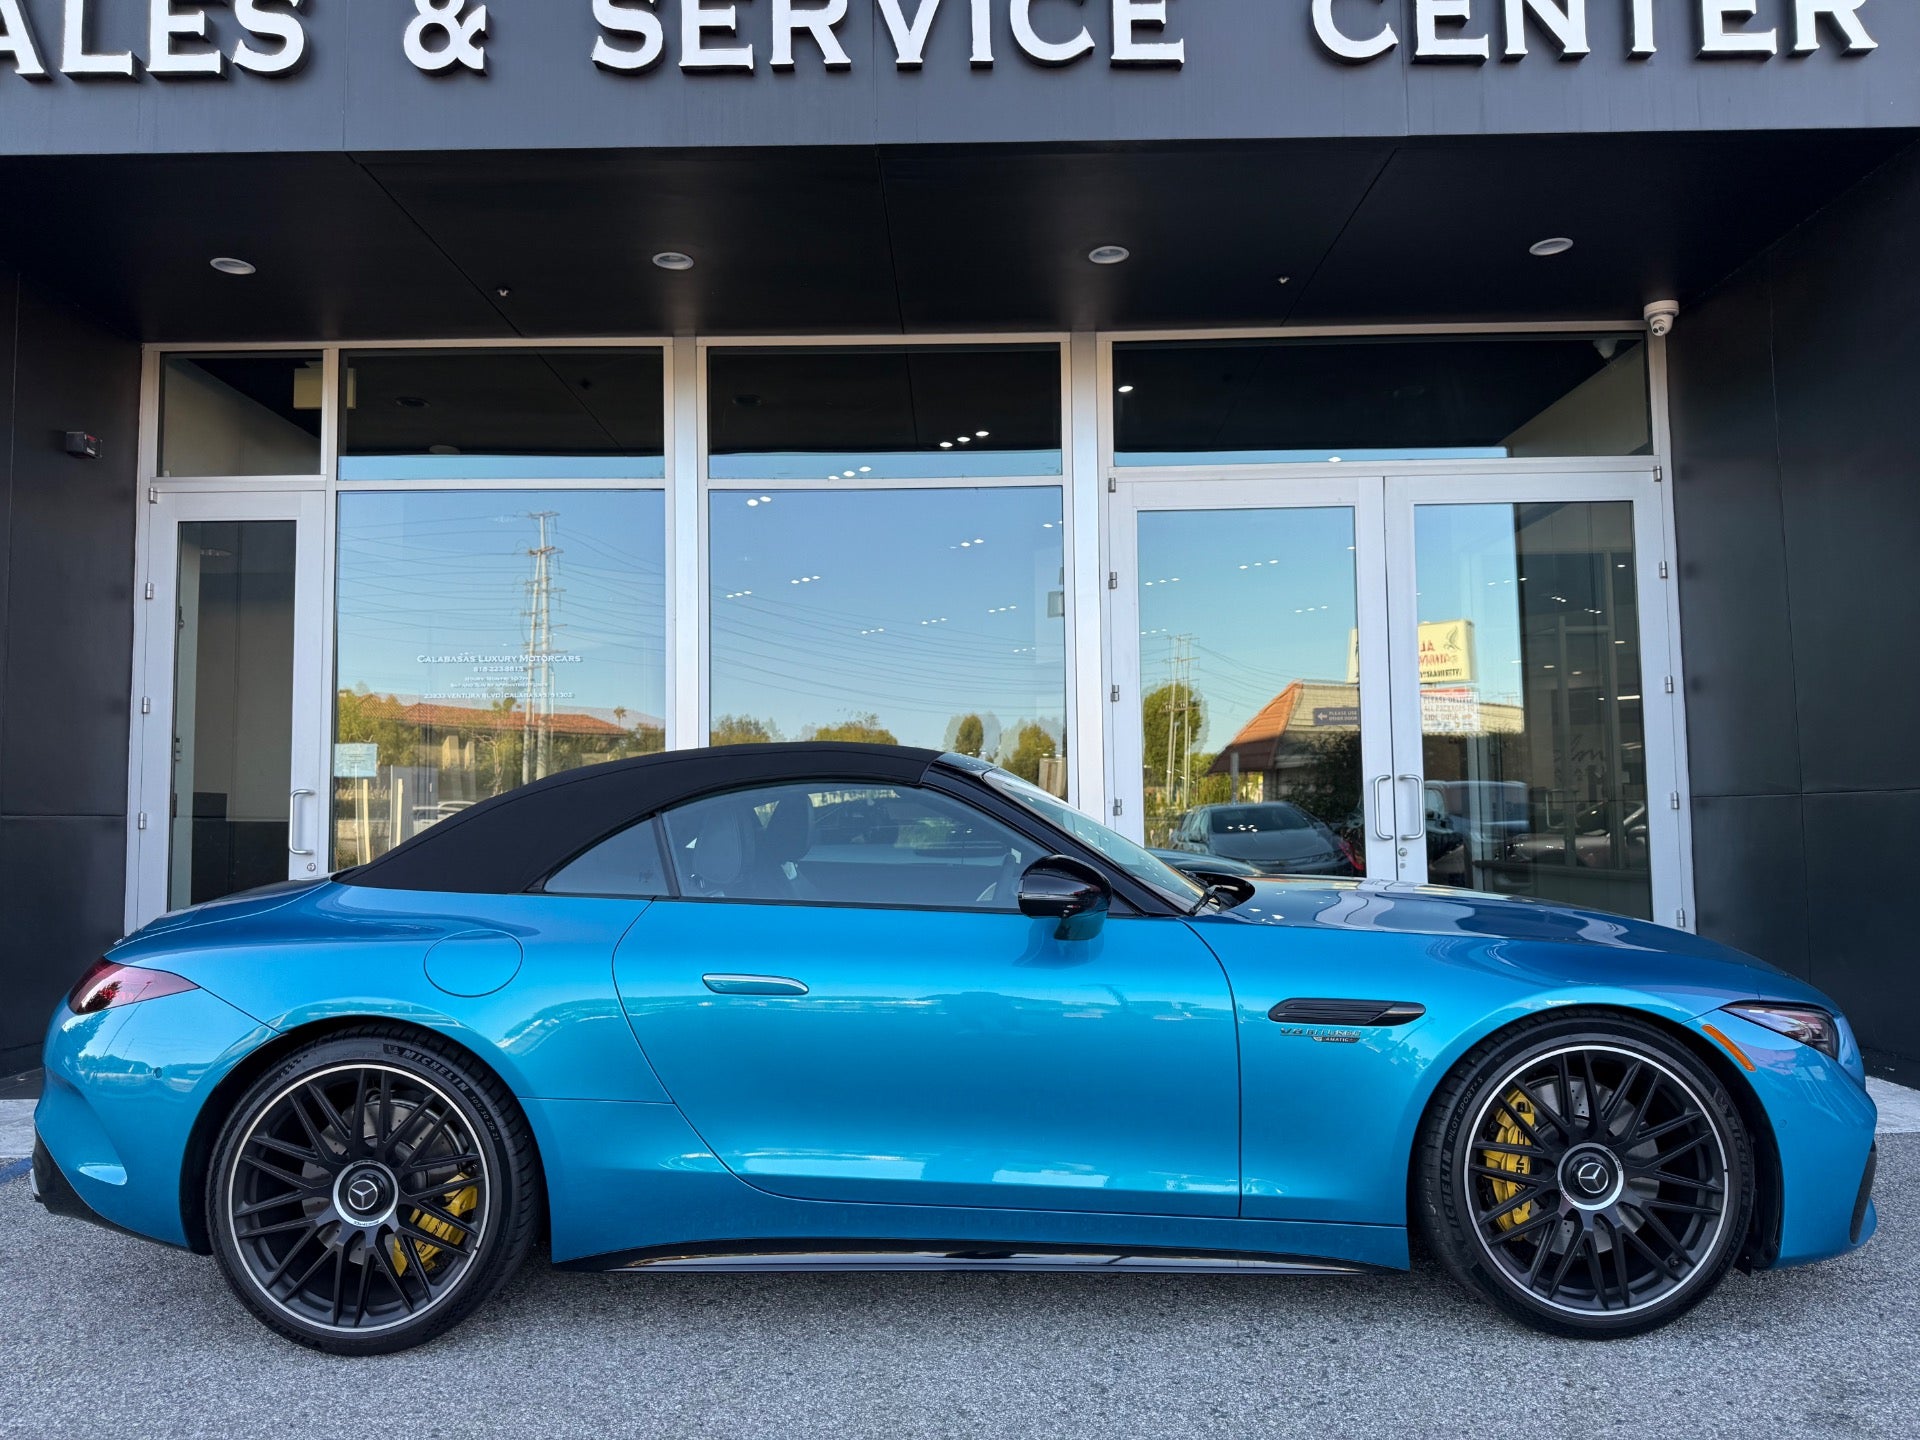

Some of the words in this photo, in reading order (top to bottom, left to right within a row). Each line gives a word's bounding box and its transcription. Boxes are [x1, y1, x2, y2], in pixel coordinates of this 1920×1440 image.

[404, 0, 488, 72] &
[592, 0, 1185, 69] SERVICE
[1312, 0, 1878, 61] CENTER
[416, 654, 476, 663] CALABASAS
[478, 654, 518, 663] LUXURY
[519, 654, 581, 663] MOTORCARS
[402, 1049, 470, 1092] MICHELIN
[1447, 1115, 1461, 1142] PILOT
